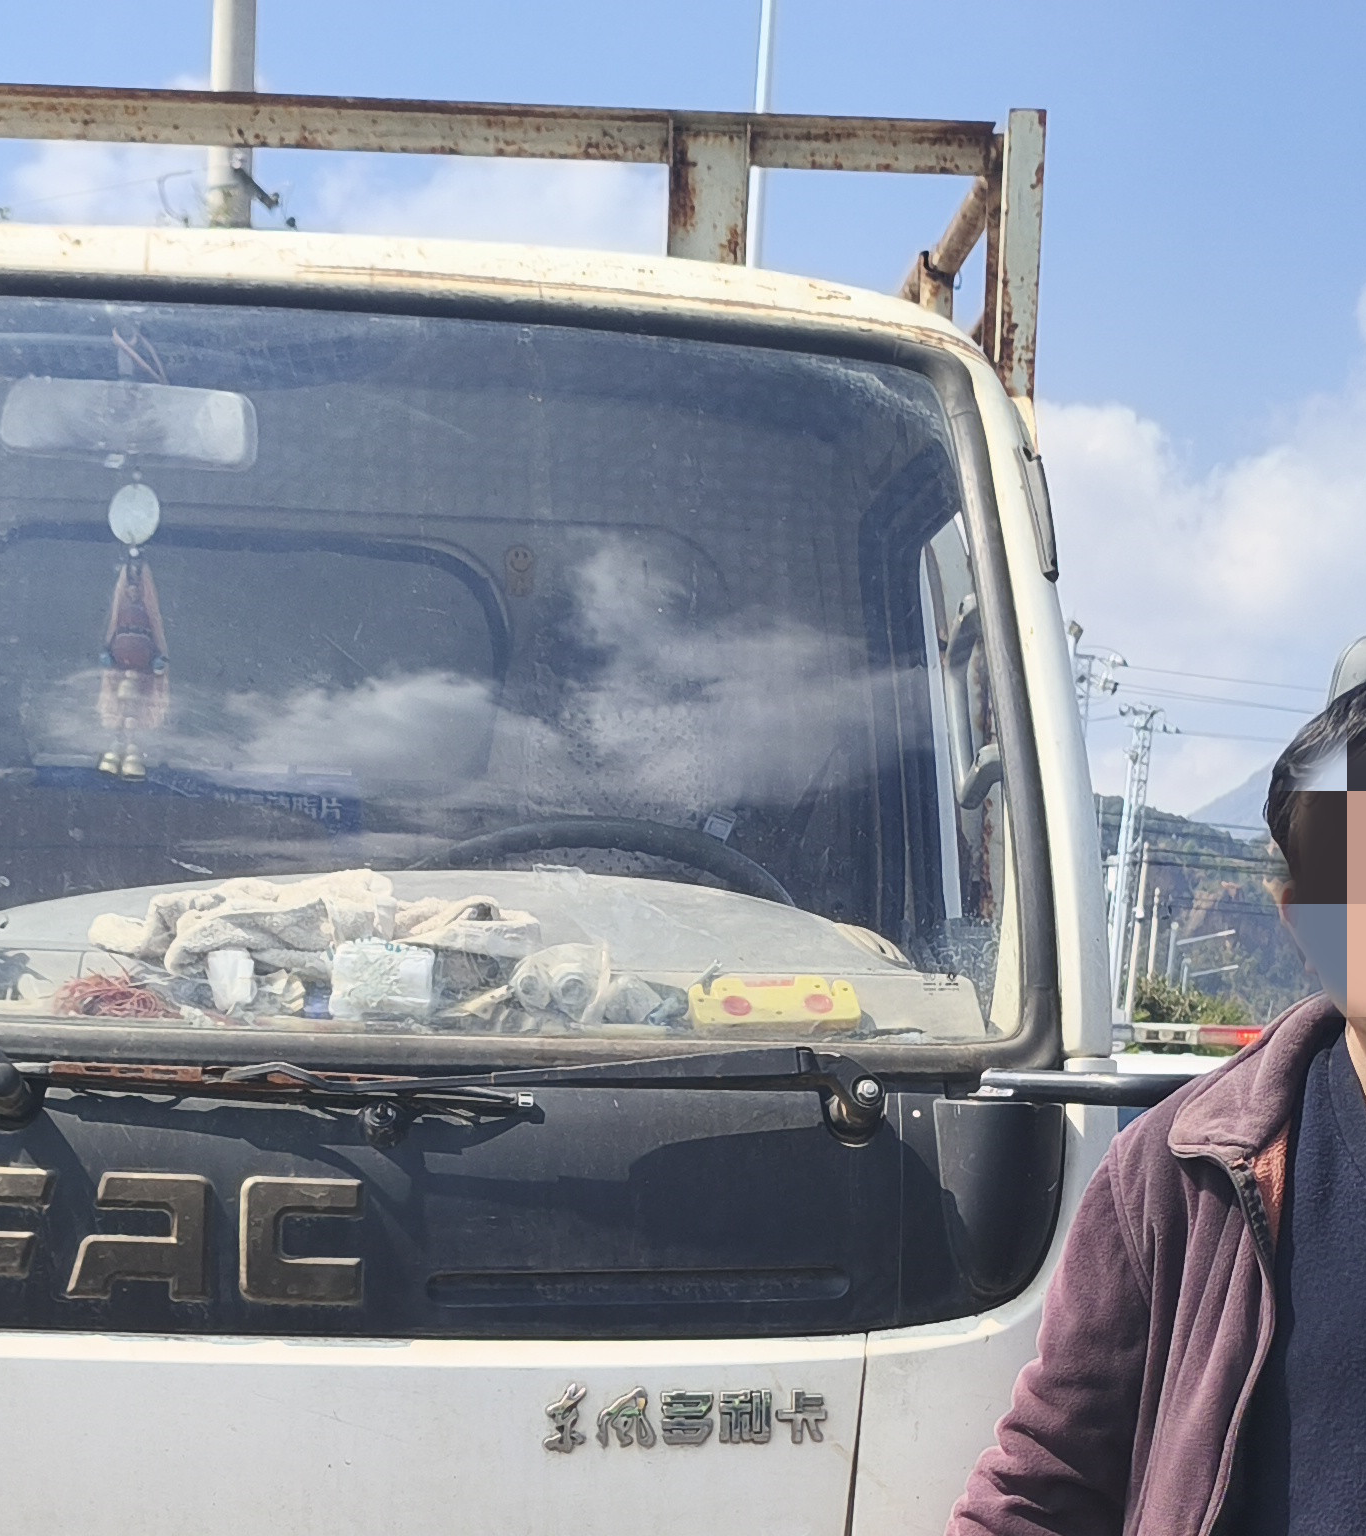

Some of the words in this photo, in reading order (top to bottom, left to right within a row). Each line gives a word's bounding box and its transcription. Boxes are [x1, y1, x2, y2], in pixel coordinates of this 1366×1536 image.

[542, 1382, 828, 1454] 东风多利卡
